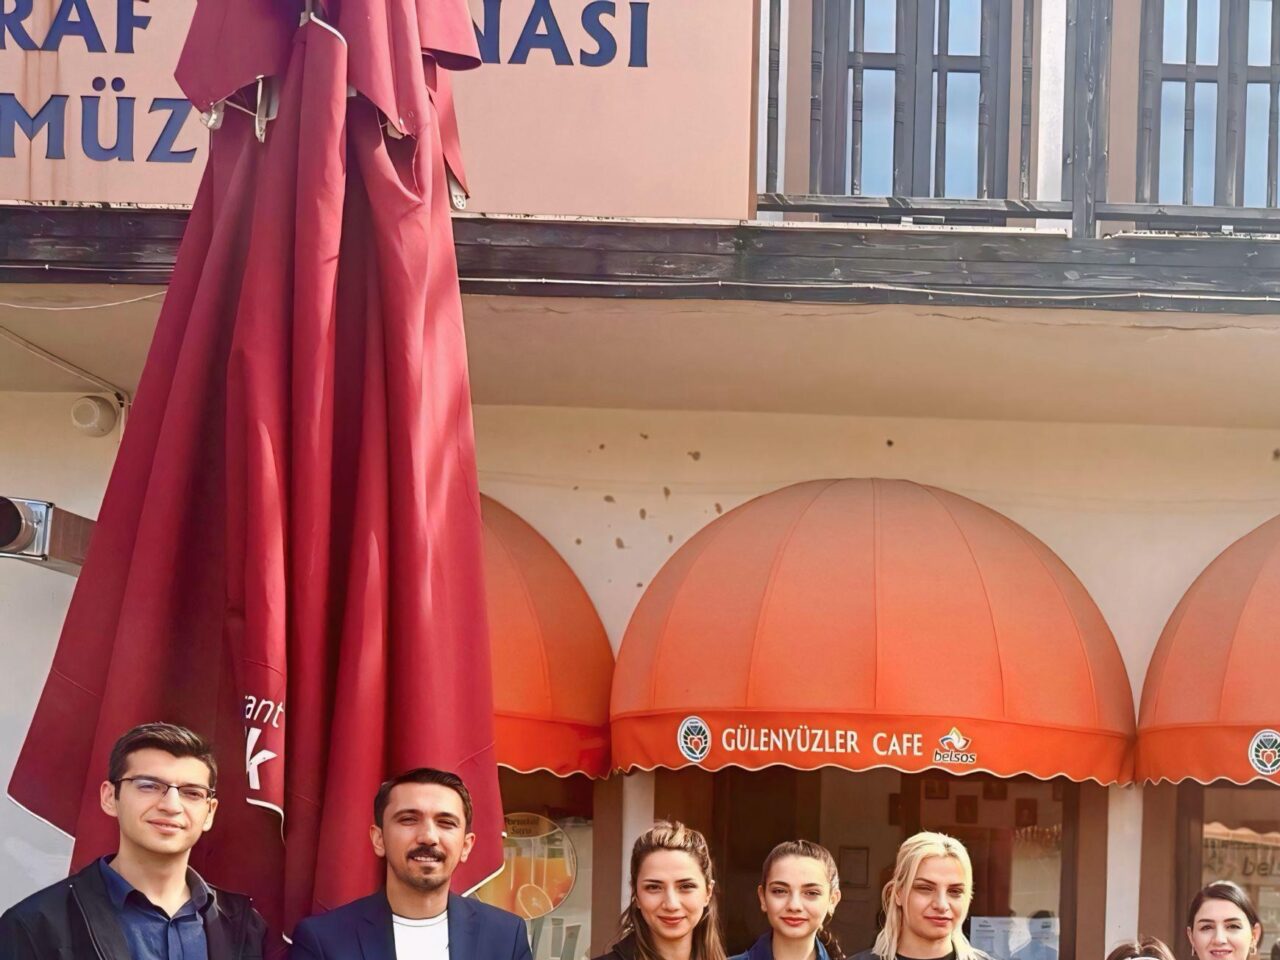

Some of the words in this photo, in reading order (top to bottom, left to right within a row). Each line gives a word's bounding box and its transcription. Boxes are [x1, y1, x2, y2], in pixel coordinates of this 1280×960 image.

[0, 0, 152, 53] RAF
[722, 724, 860, 753] GÜLENYÜZLER
[872, 732, 923, 756] CAFE
[933, 749, 977, 763] belsos
